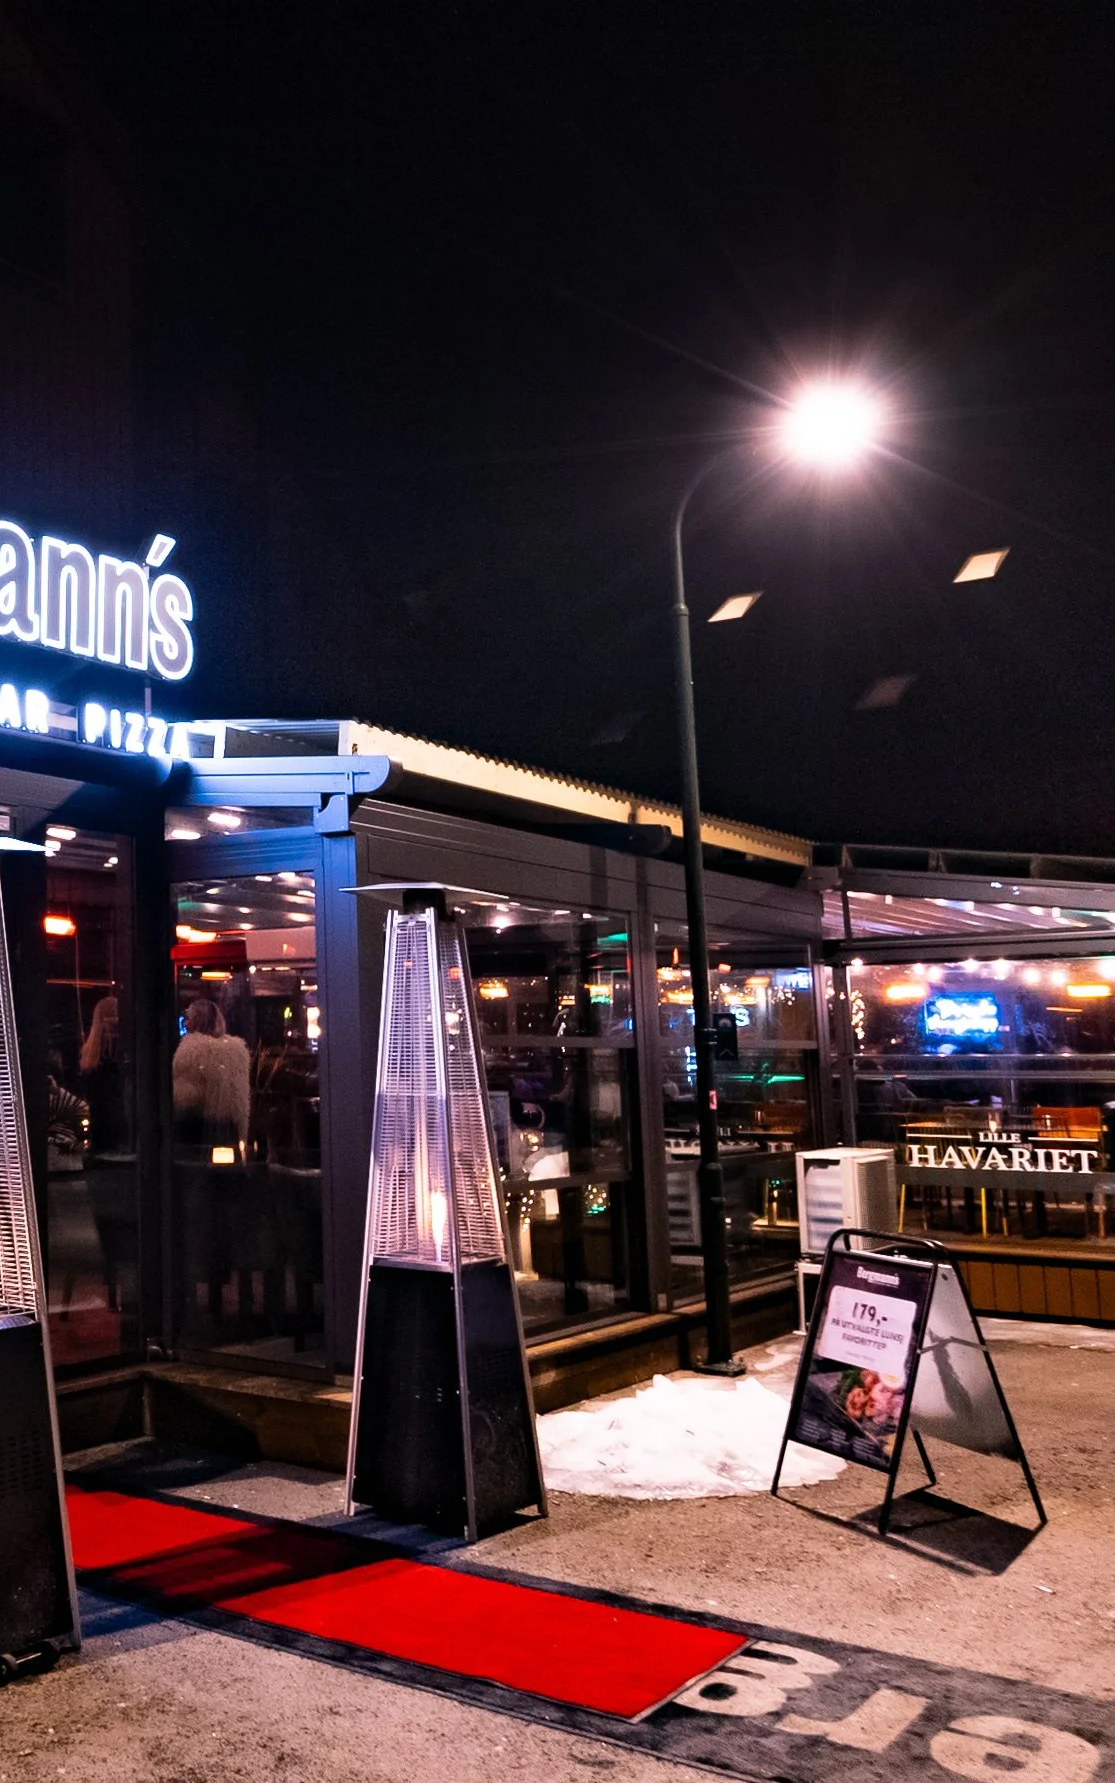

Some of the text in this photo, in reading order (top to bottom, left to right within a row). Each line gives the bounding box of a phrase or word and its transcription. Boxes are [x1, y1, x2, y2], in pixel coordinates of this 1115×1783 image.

[978, 1131, 1022, 1143] LILLE
[908, 1144, 1099, 1174] HAVARIET
[852, 1302, 887, 1327] 179,-
